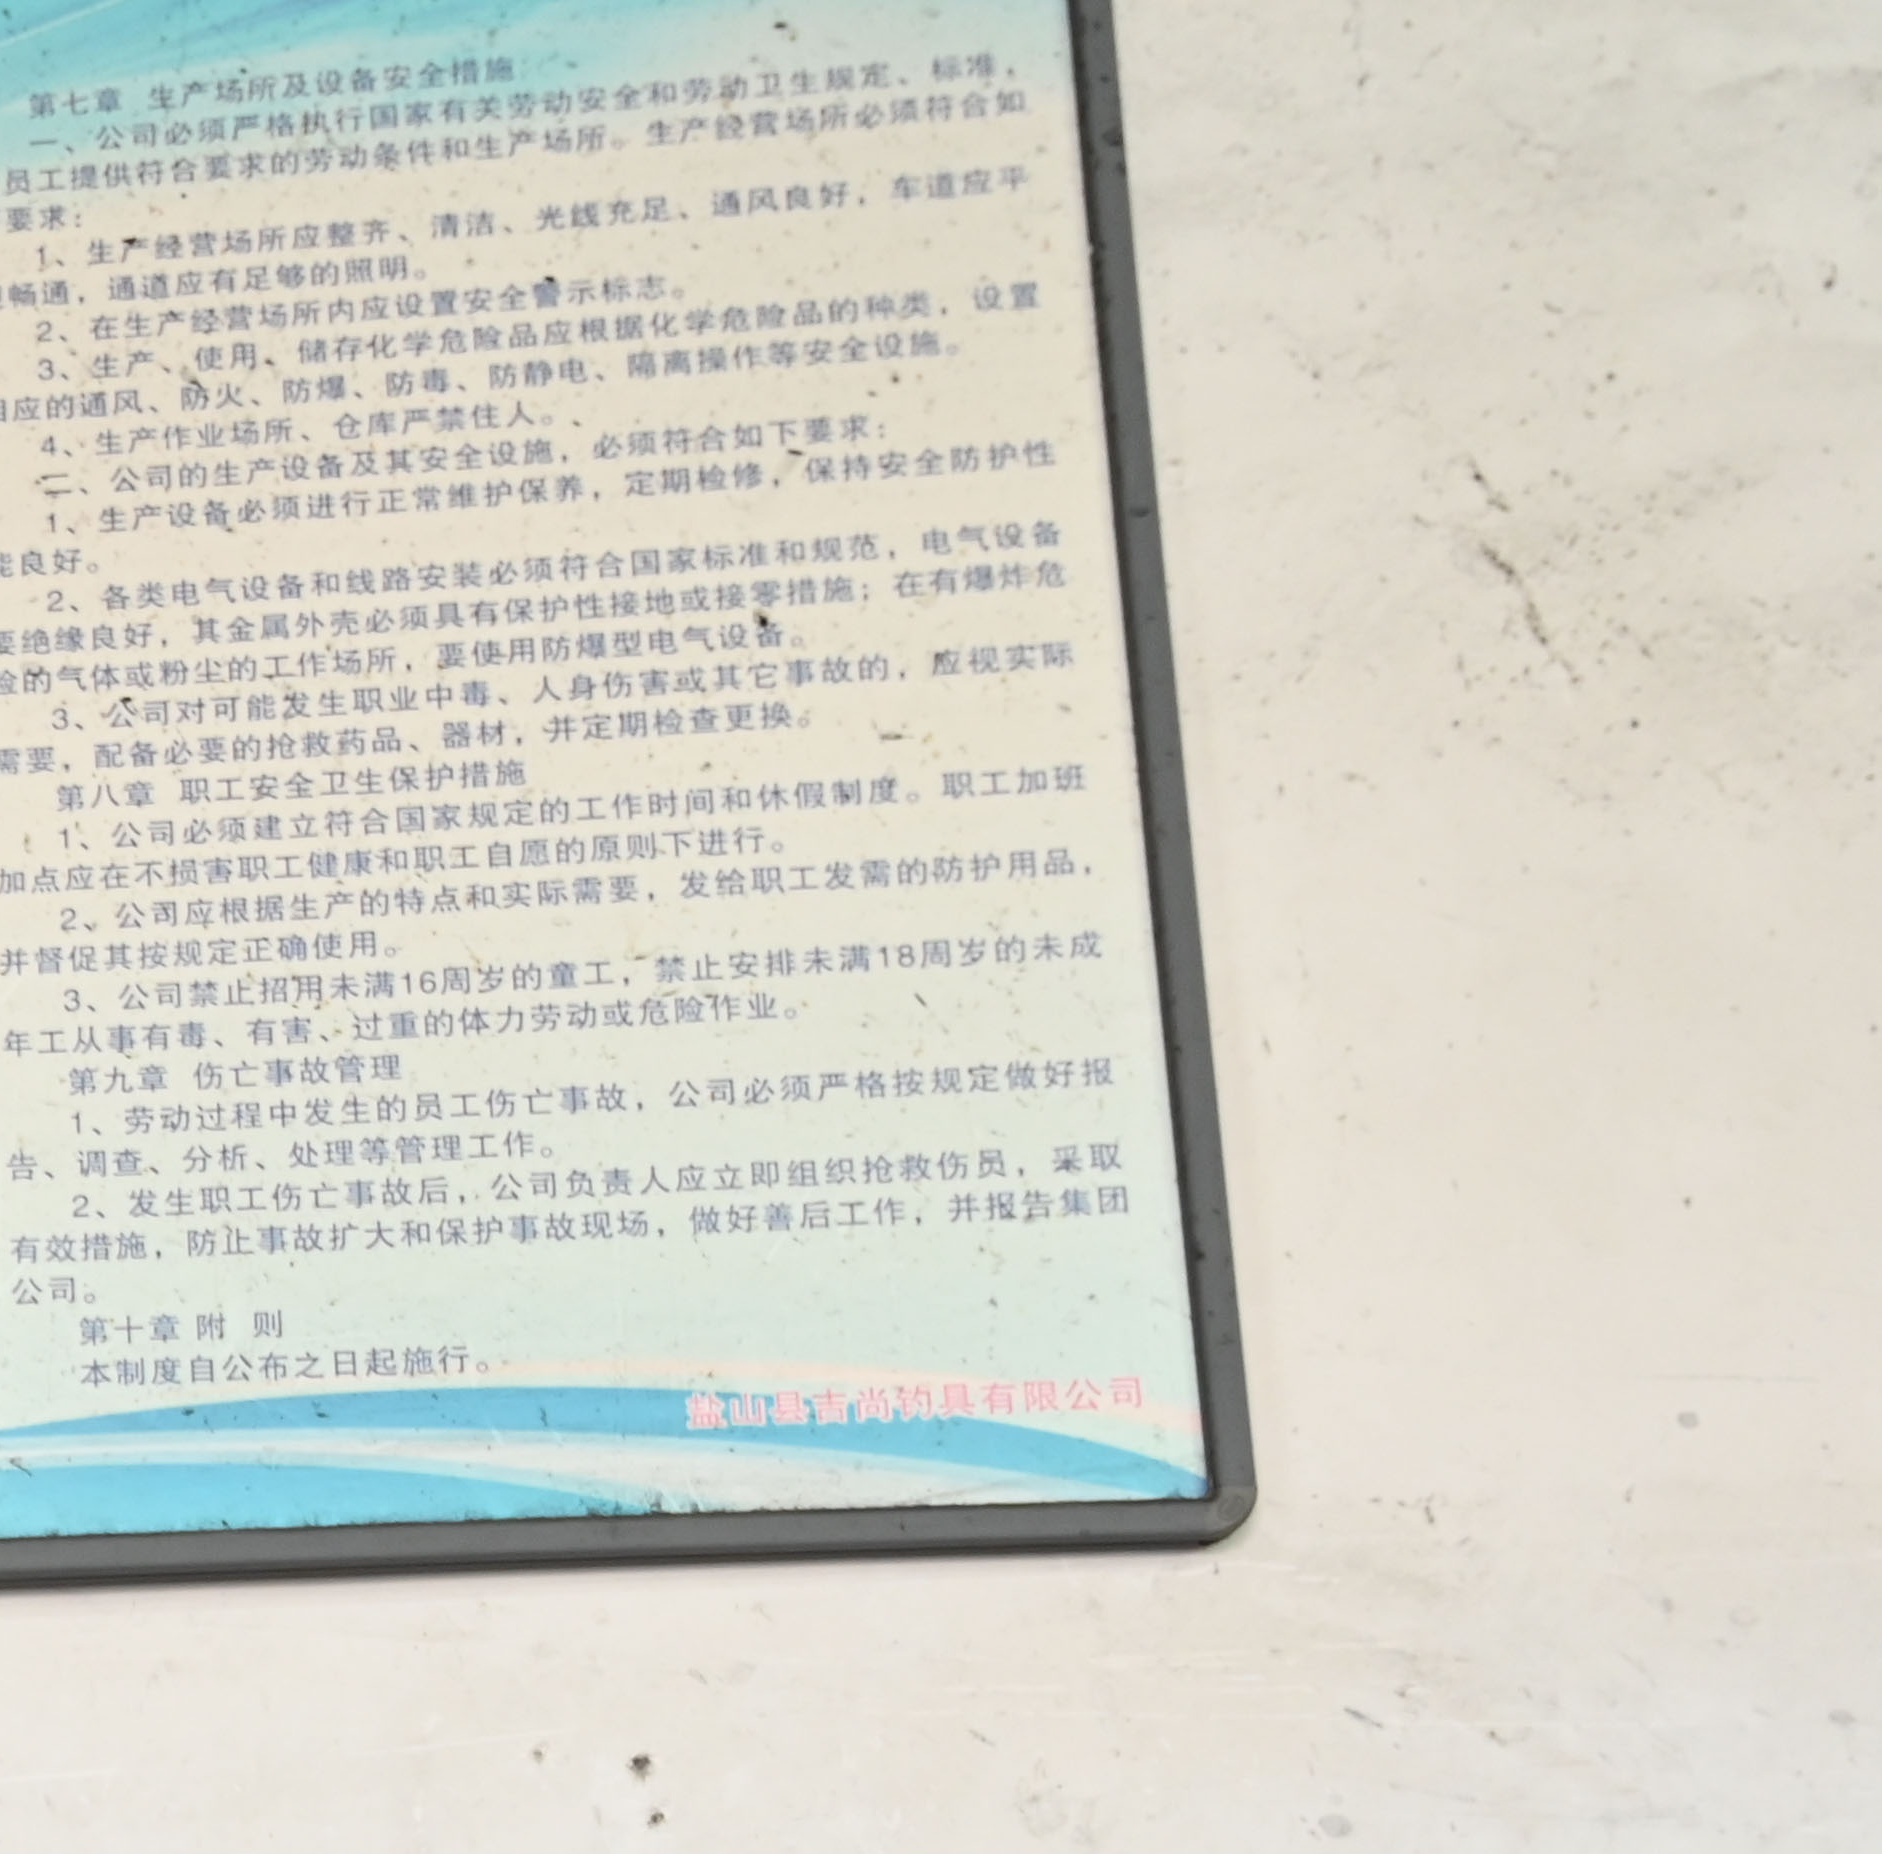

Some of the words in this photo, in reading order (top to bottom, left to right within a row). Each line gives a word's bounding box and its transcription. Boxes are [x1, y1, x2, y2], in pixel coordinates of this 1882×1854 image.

[30, 86, 124, 121] 第七章
[150, 54, 512, 111] 生产场所及设备安全措施
[35, 268, 689, 348] 2、在生产经营场所内应设置安全警示标志。
[39, 398, 553, 460] 4、生产作业场所、仓库严禁住人。
[56, 778, 154, 813] 第八章
[179, 757, 526, 806] 职工安全卫生保护措施
[59, 763, 1085, 853] 1、公司必须建立符合国家规定的工作时间和休假制度。职工加班
[3, 989, 805, 1059] 年工从事有毒、有害、过重的体力劳动或危险作业。
[61, 1062, 167, 1097] 第九章
[192, 1051, 401, 1091] 伤亡事故管理
[71, 1056, 1114, 1139] 1、劳动过程中发生的员工伤亡事故，公司必须严格按规定做好报
[6, 1127, 561, 1182] 告、调查、分析、处理等管理工作。
[11, 1273, 102, 1308] 公司。
[79, 1312, 179, 1347] 第十章
[80, 1342, 488, 1389] 本制度自公布之日起施行。
[687, 1371, 1147, 1432] 盐山县吉尚钓具有限公司
